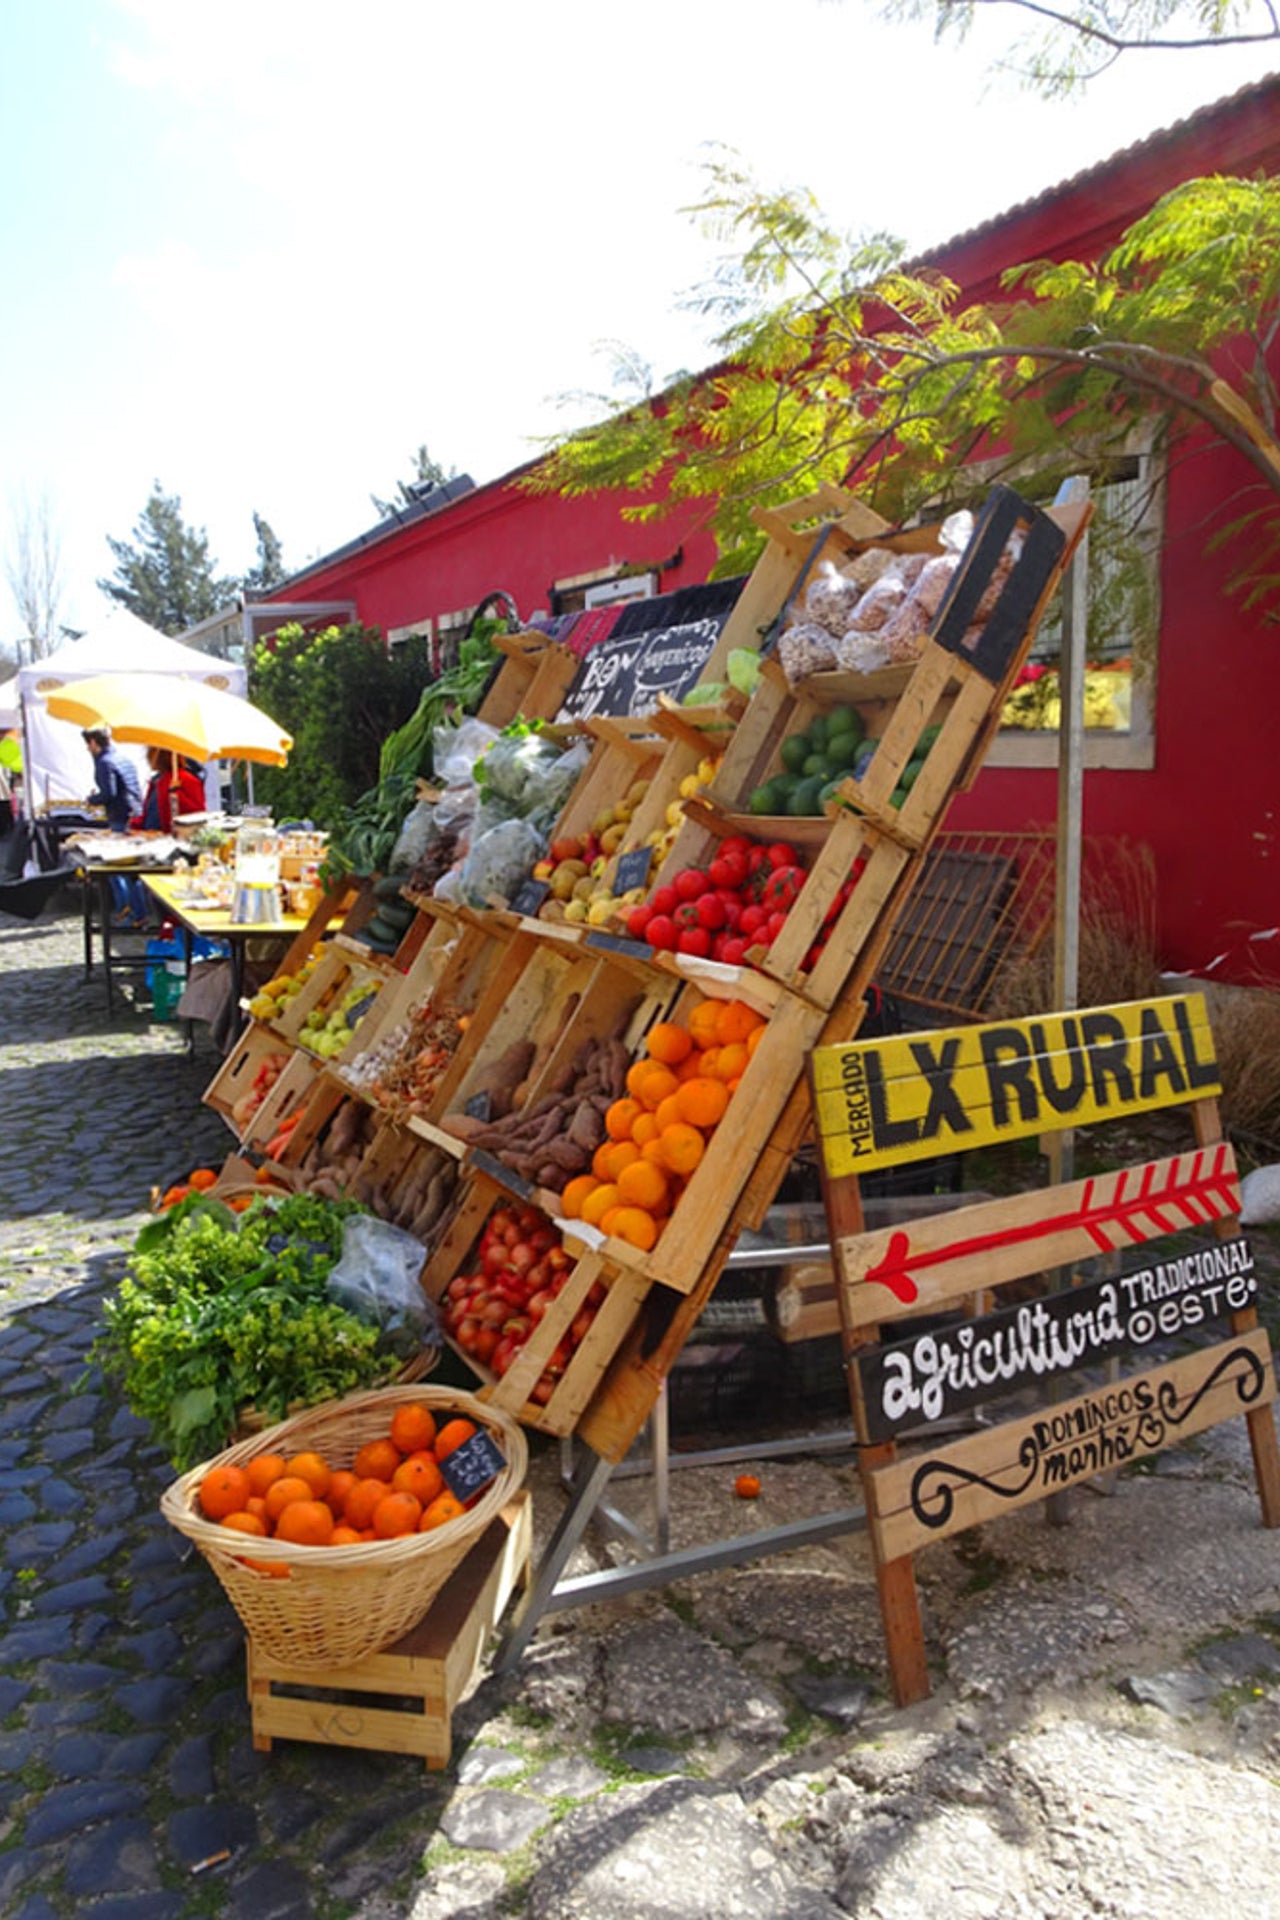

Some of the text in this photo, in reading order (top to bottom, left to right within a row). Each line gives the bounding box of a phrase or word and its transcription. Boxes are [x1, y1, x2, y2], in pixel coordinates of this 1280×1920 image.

[840, 1050, 872, 1158] MERCADO
[863, 1001, 1221, 1151] LX RURAL
[1120, 1240, 1254, 1309] TRADICIONAL
[882, 1282, 1124, 1420] agricultura
[1044, 1426, 1134, 1485] manhã
